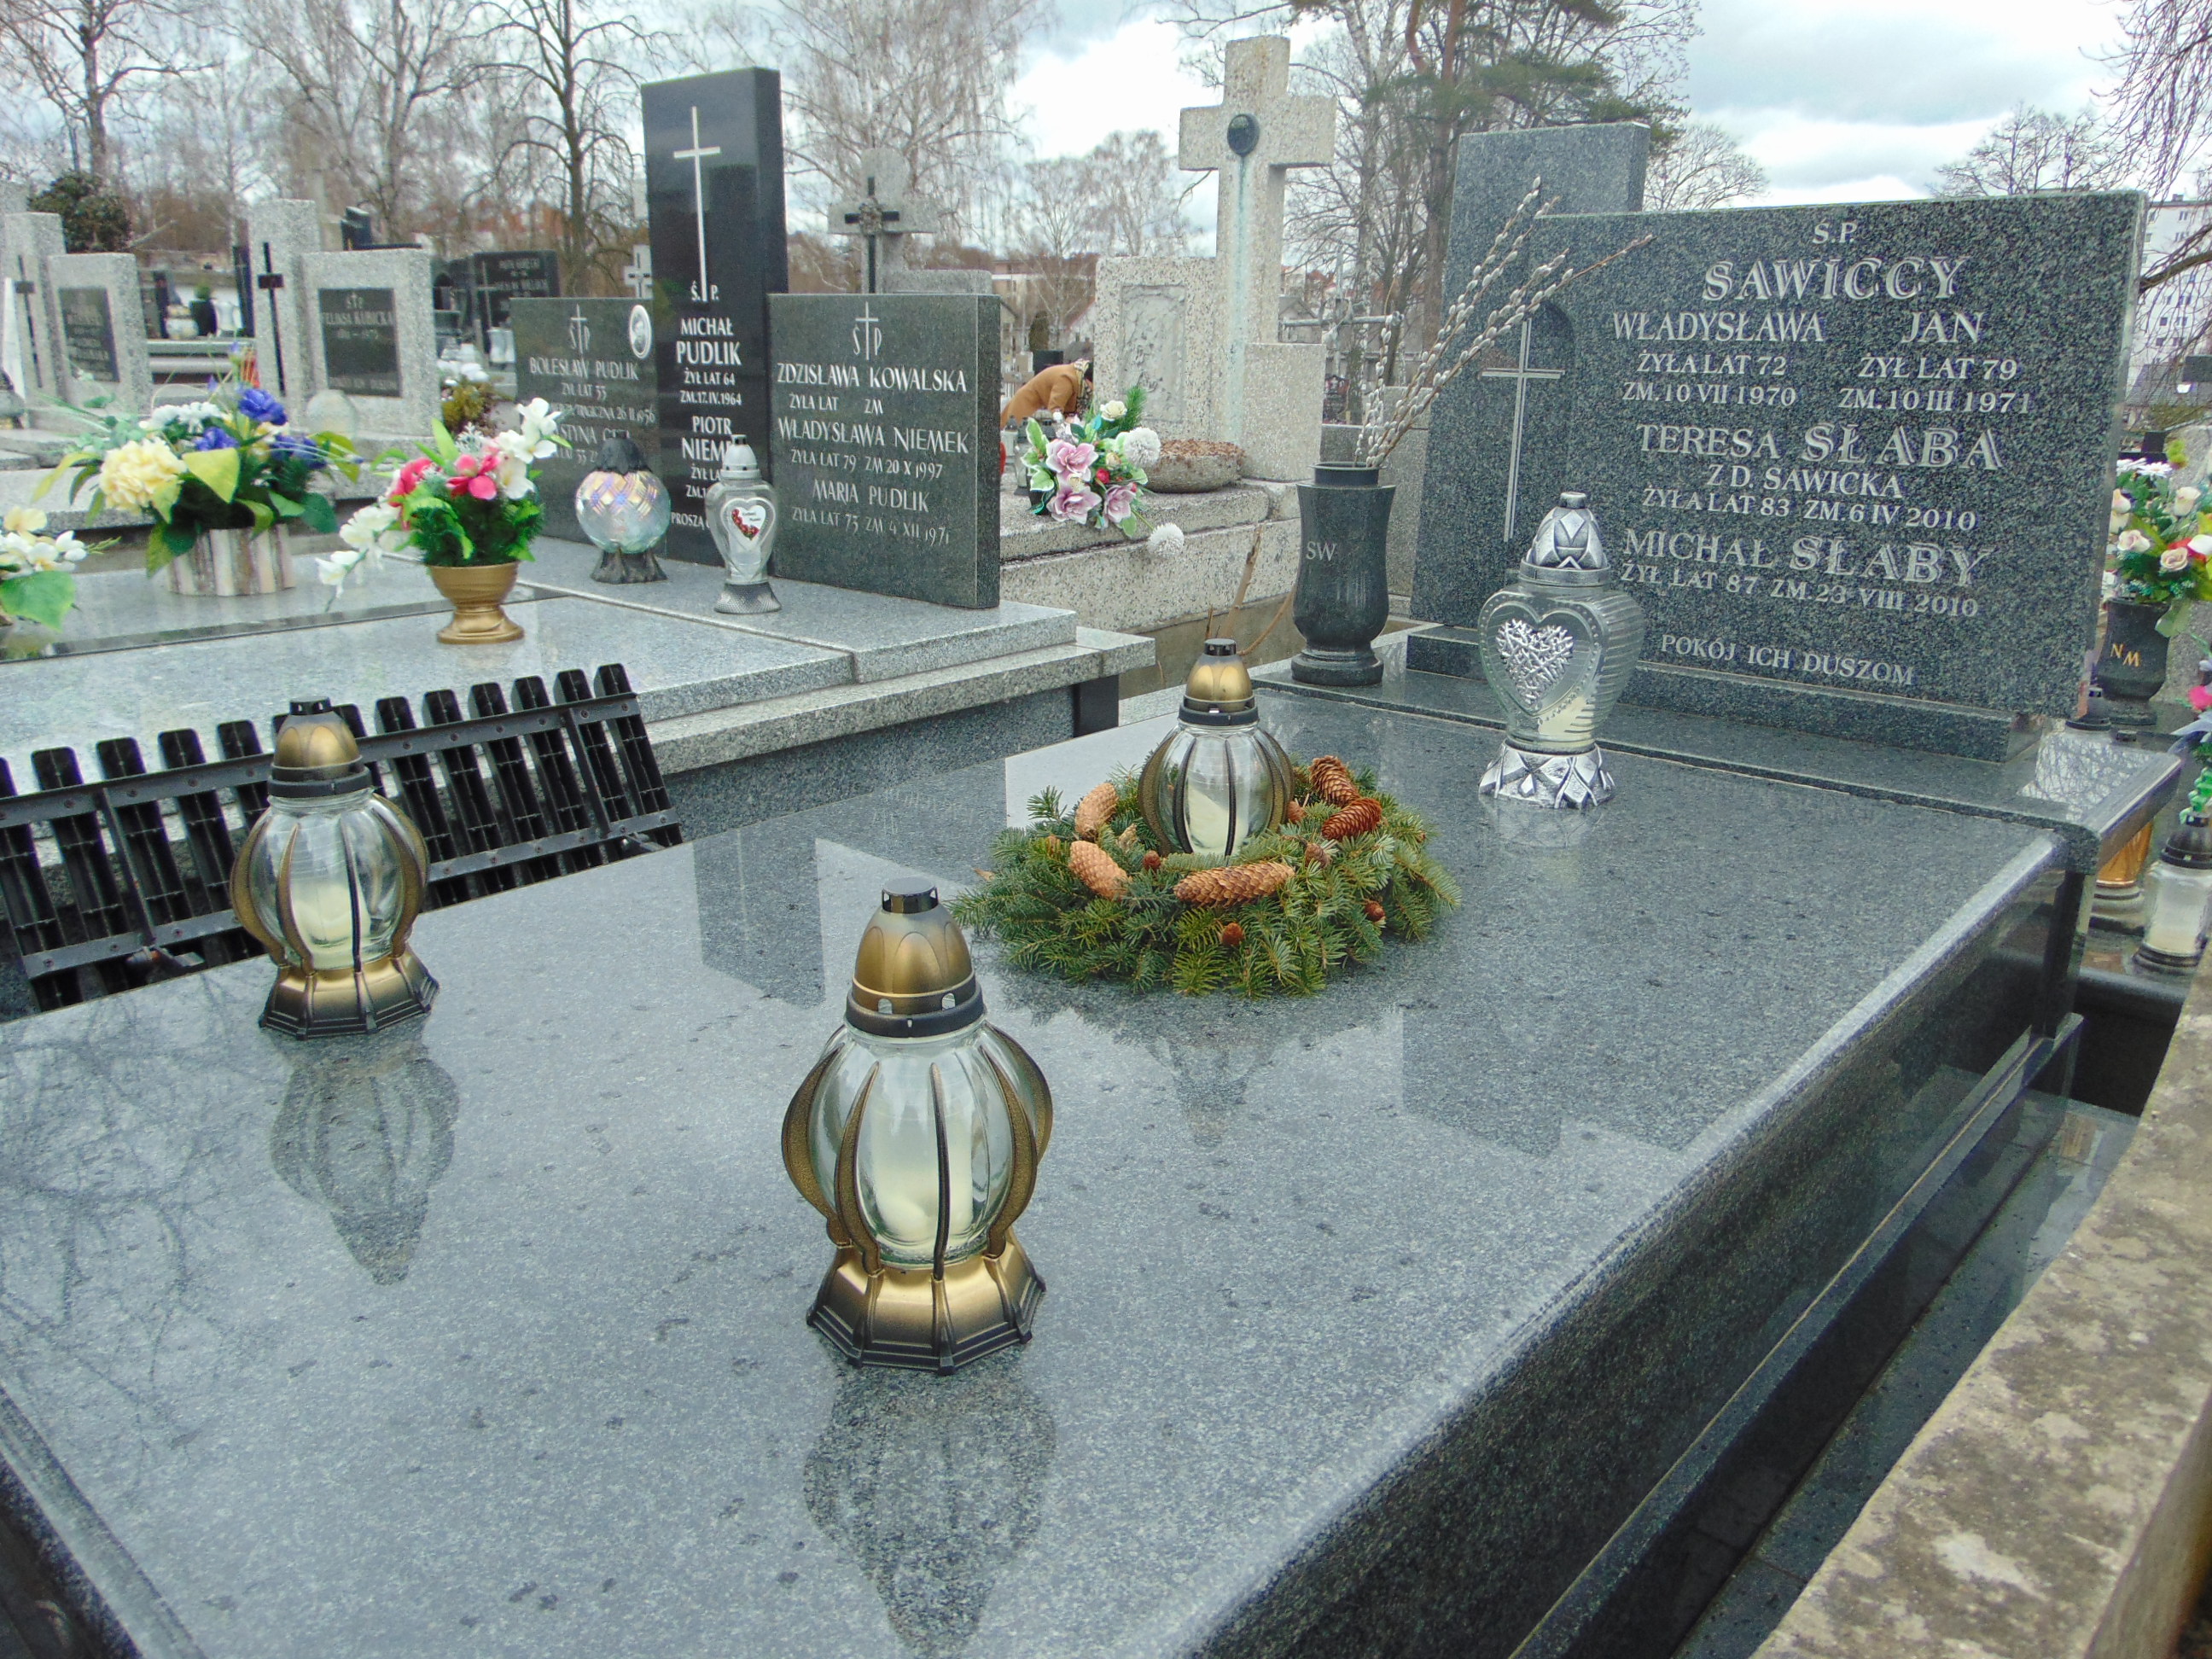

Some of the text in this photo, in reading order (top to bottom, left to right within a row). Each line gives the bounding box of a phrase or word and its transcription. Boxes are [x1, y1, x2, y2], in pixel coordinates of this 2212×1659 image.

[1703, 257, 1970, 301] SAWICCY
[680, 317, 734, 337] MICHAŁ
[1612, 311, 1825, 342] WŁADYSŁAWA
[1901, 311, 1985, 343] JAN
[676, 340, 742, 366] PUDLIK
[1636, 349, 1788, 376] ŻYŁA LAT 72
[1858, 352, 2017, 381] ŻYŁ LAT 79
[597, 360, 639, 381] PUDLIK
[684, 367, 736, 386] ŻYŁ LAT 64
[870, 364, 967, 393] KOWALSKA
[818, 394, 839, 410] LAT
[864, 399, 883, 416] ZM
[1698, 384, 1728, 405] VII
[1738, 386, 1796, 407] 1970
[1926, 389, 1954, 411] III
[1964, 391, 2030, 415] 1971
[692, 415, 732, 435] PIOTR
[894, 426, 969, 455] NIEMEK
[1637, 422, 2004, 470] TERESA SŁABA
[690, 463, 707, 480] ŻYŁ
[820, 451, 840, 467] LAT
[843, 454, 857, 473] 79
[865, 456, 883, 474] ZM
[887, 459, 899, 474] 20
[903, 461, 911, 475] X
[915, 461, 943, 482] 1997
[1707, 463, 1902, 498] Z D. SAWICKA
[812, 478, 929, 513] MARIA PUDLIK
[1643, 484, 1703, 510] ŻYŁA
[1708, 492, 1755, 514] LAT
[1761, 498, 1790, 517] 83
[1871, 504, 1900, 525] IV
[1906, 507, 1976, 531] 2010
[671, 512, 706, 531] PROSZĄ
[820, 511, 841, 527] LAT
[866, 516, 883, 534] ZM
[889, 519, 897, 535] 4
[925, 526, 949, 547] 1971
[1306, 540, 1338, 562] SW
[1623, 527, 2001, 588] MICHAŁ SŁABY
[1621, 560, 1663, 584] ŻYŁ
[1670, 567, 1718, 590] LAT
[1726, 575, 1758, 594] 87
[1859, 587, 1906, 610] VIII
[1915, 592, 1978, 617] 2010
[1661, 634, 1916, 685] POKÓJ ICH DUSZOM
